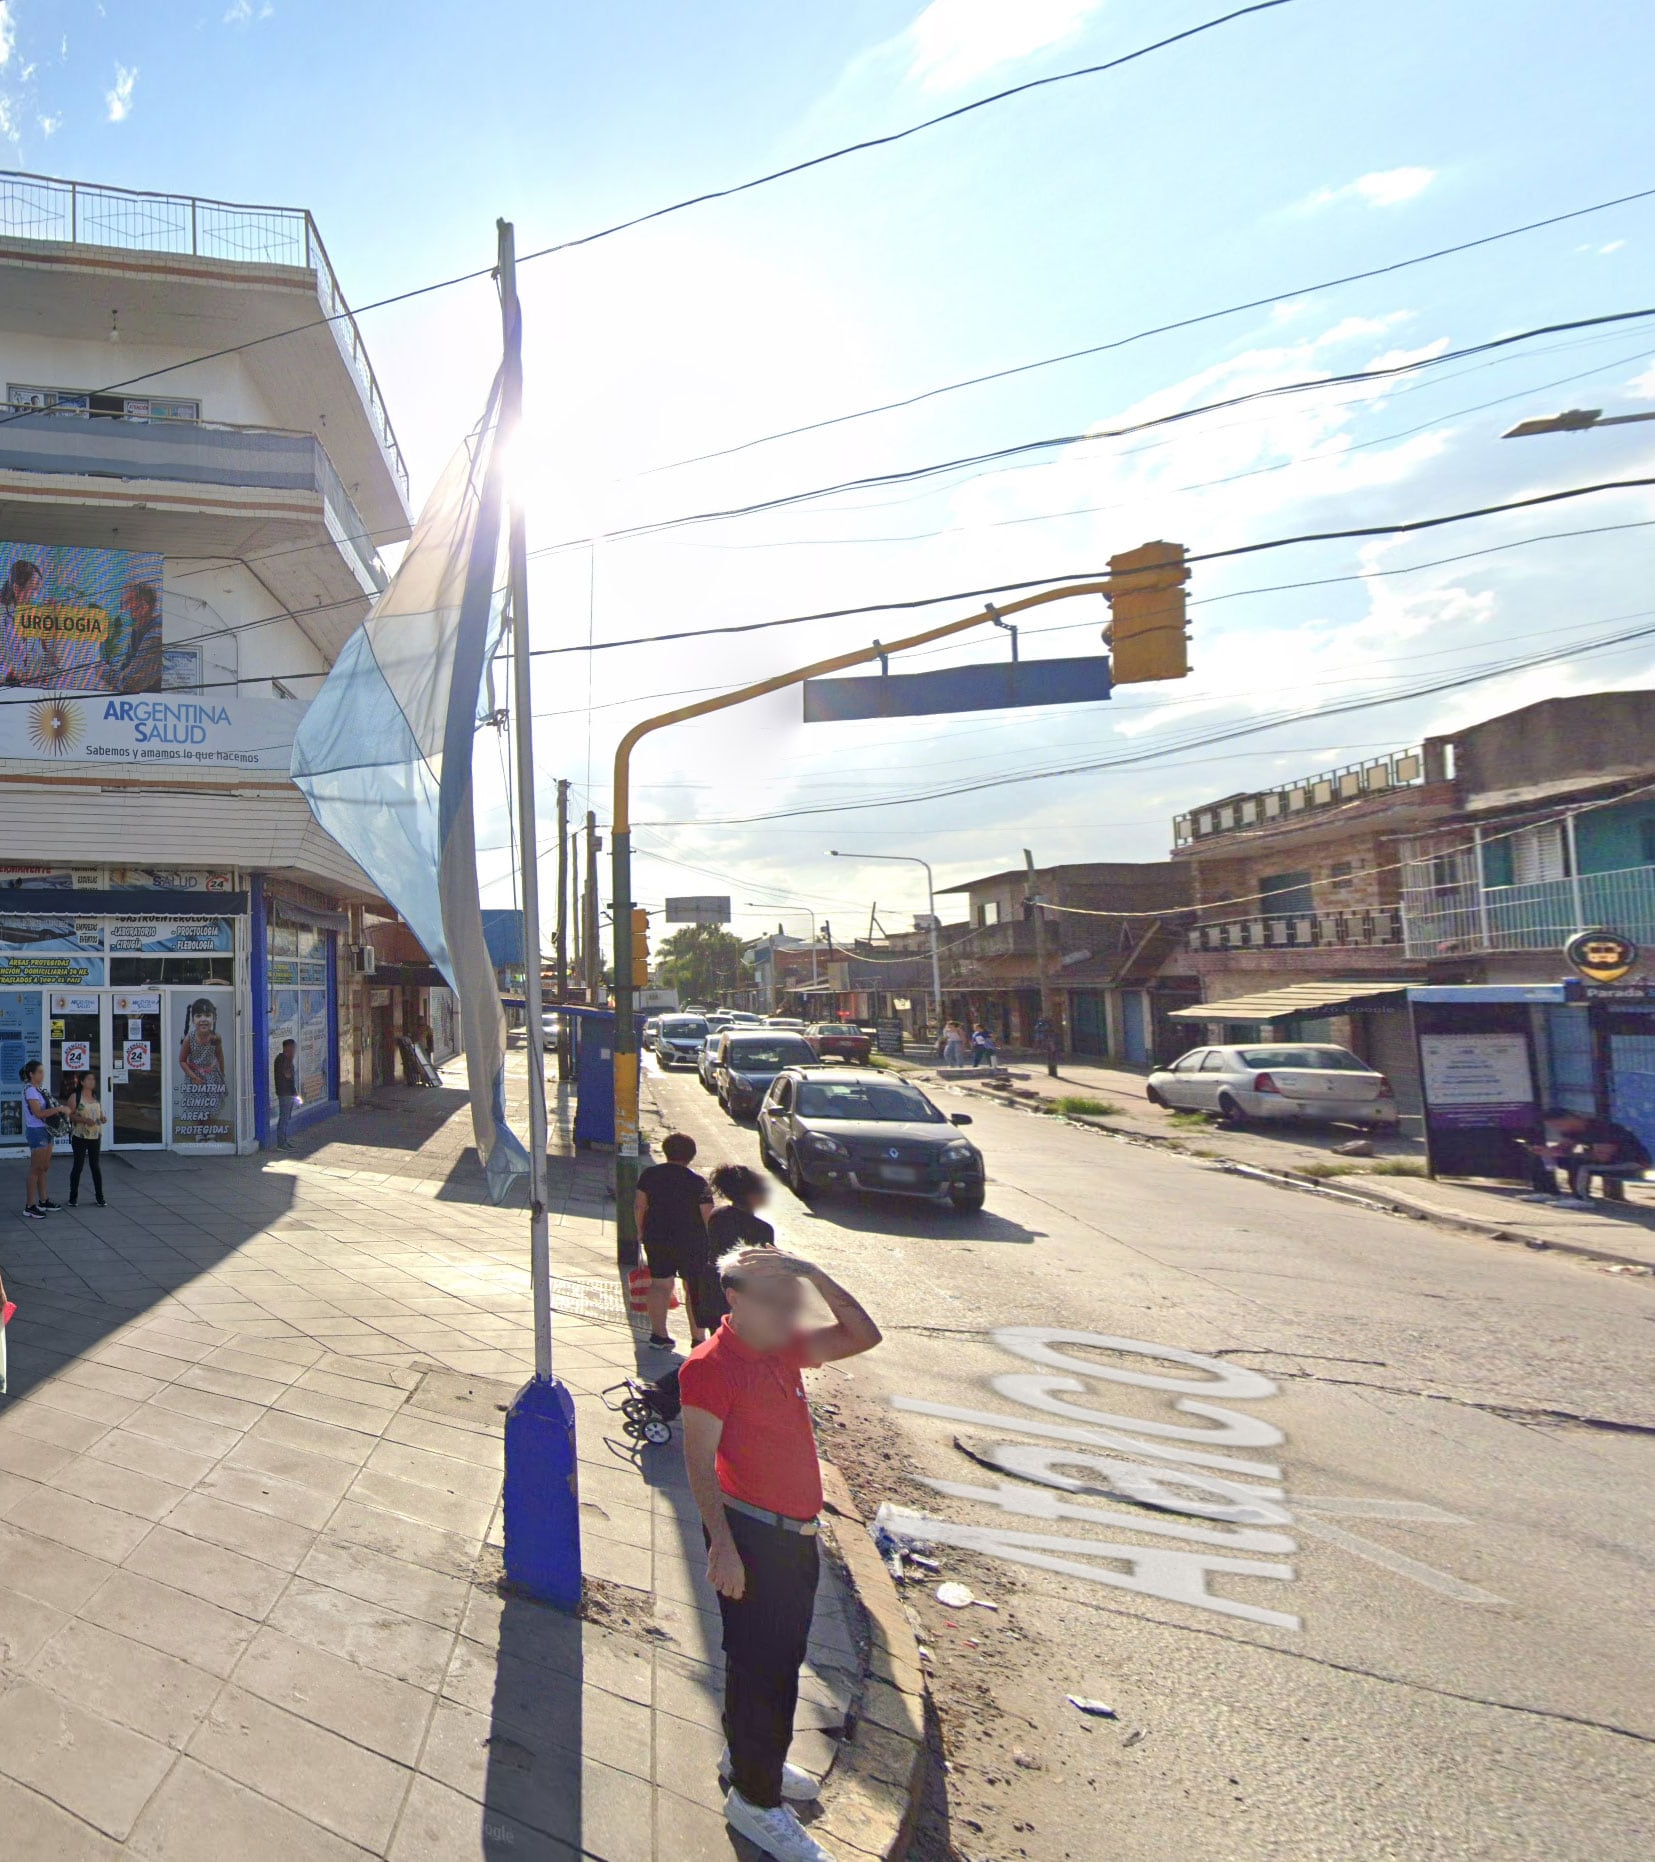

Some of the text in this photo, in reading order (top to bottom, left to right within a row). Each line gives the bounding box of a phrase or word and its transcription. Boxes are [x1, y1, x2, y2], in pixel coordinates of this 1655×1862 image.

[103, 700, 232, 726] ARGENTINA
[134, 722, 207, 744] SALUD
[86, 745, 129, 758] Sabemos
[140, 749, 182, 759] amamos
[183, 748, 193, 759] lo
[194, 751, 214, 761] que
[216, 749, 259, 763] hacemos
[152, 875, 198, 888] SALUD
[210, 880, 224, 888] 24
[1587, 988, 1644, 998] Parada
[69, 1052, 82, 1062] 24
[130, 1052, 143, 1061] 24
[175, 1125, 230, 1135] PROTEGIDAS
